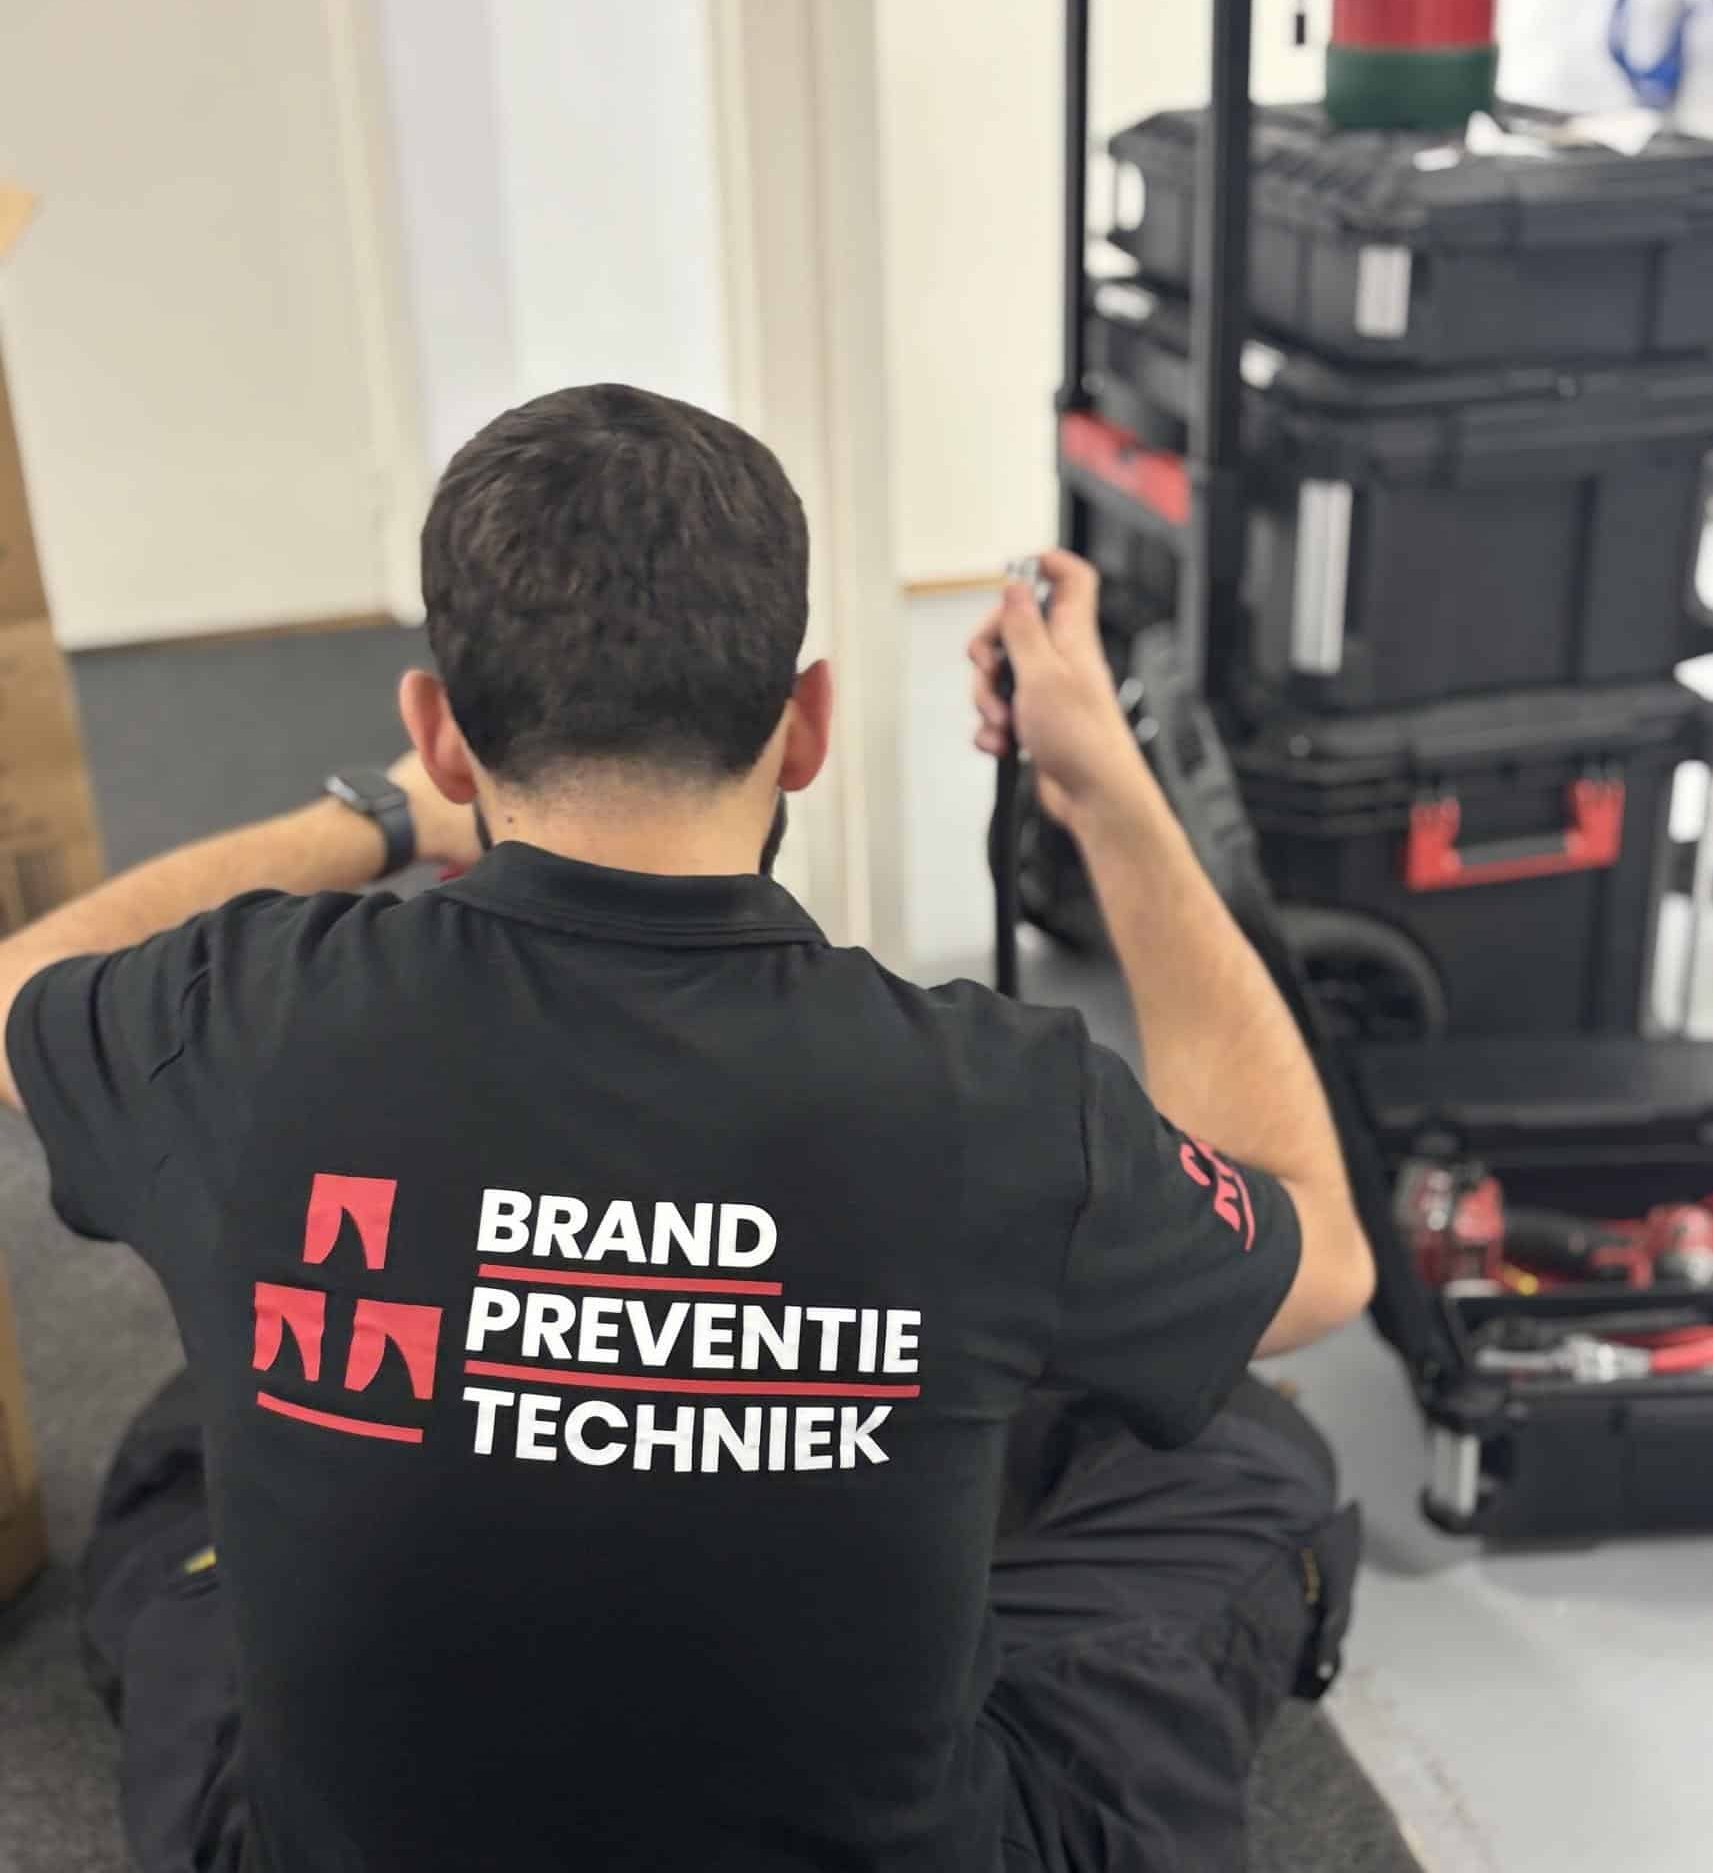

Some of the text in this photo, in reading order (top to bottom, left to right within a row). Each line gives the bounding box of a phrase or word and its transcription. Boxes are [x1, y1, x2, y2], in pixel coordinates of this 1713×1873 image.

[476, 1188, 778, 1268] BRAND
[464, 1286, 922, 1374] PREVENTIE
[462, 1386, 893, 1473] TECHNIEK
